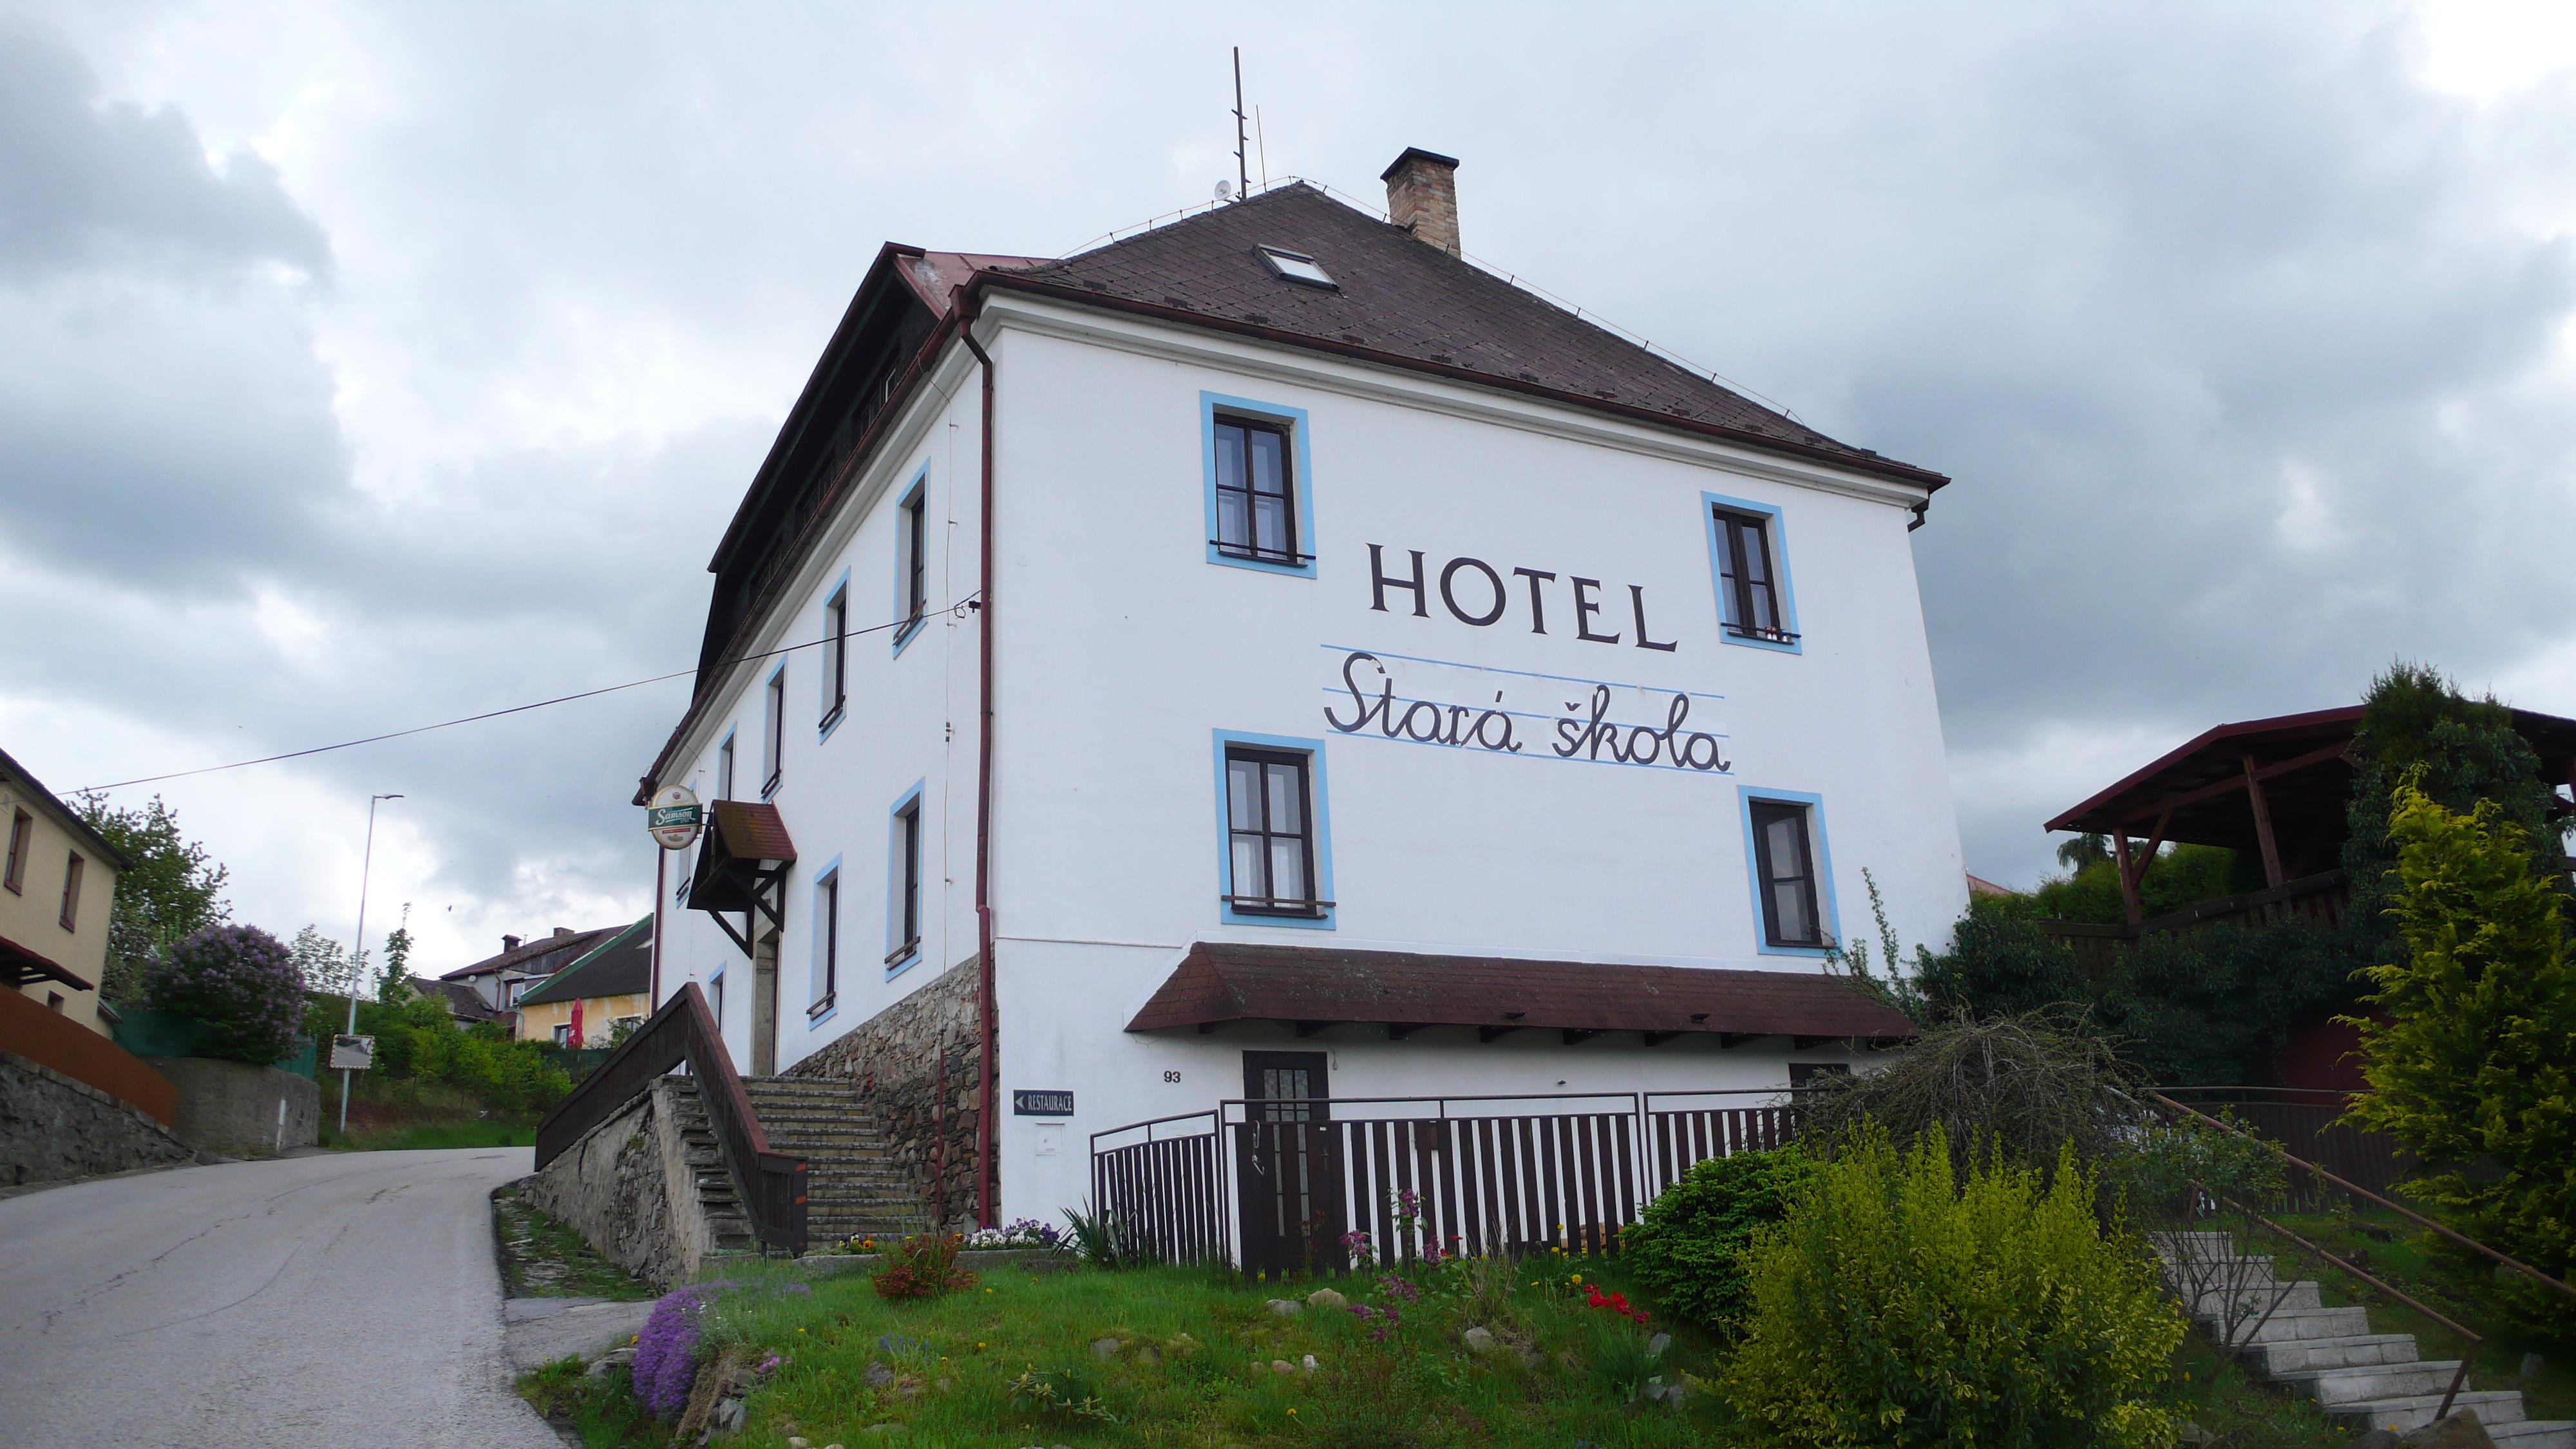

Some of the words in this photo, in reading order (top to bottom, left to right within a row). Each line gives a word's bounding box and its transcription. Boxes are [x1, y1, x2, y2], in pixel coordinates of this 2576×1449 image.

[1366, 543, 1678, 652] HOTEL
[1323, 652, 1522, 752] Stará
[1552, 685, 1731, 772] škola
[656, 808, 696, 825] Samson
[1164, 1070, 1181, 1083] 93
[1028, 1094, 1072, 1112] RESTAURACE
